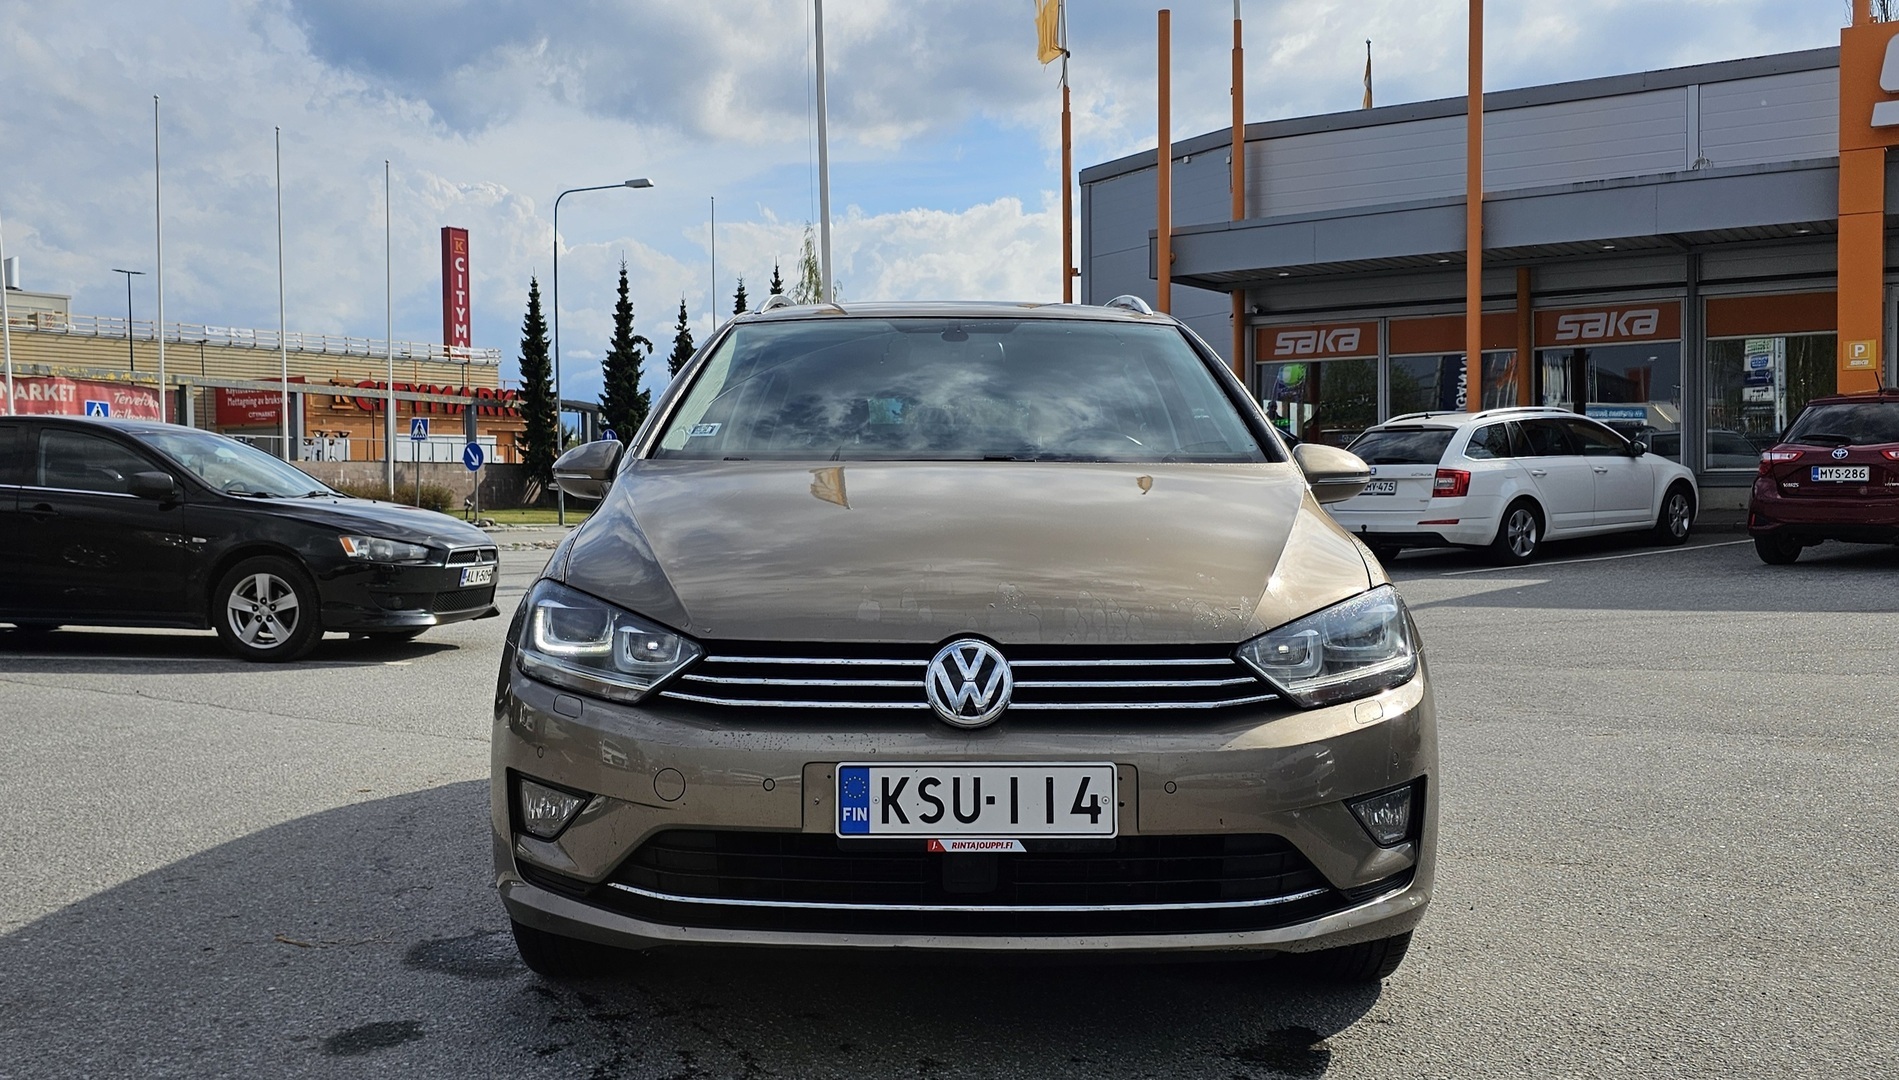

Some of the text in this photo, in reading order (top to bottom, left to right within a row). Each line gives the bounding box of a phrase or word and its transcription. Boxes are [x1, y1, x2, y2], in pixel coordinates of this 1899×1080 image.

[455, 241, 463, 251] K
[1855, 344, 1865, 357] P
[355, 380, 522, 417] CITYMARK
[843, 776, 1102, 825] FIN KSU-114
[951, 841, 1014, 850] RINTAJOUPPI.FI
